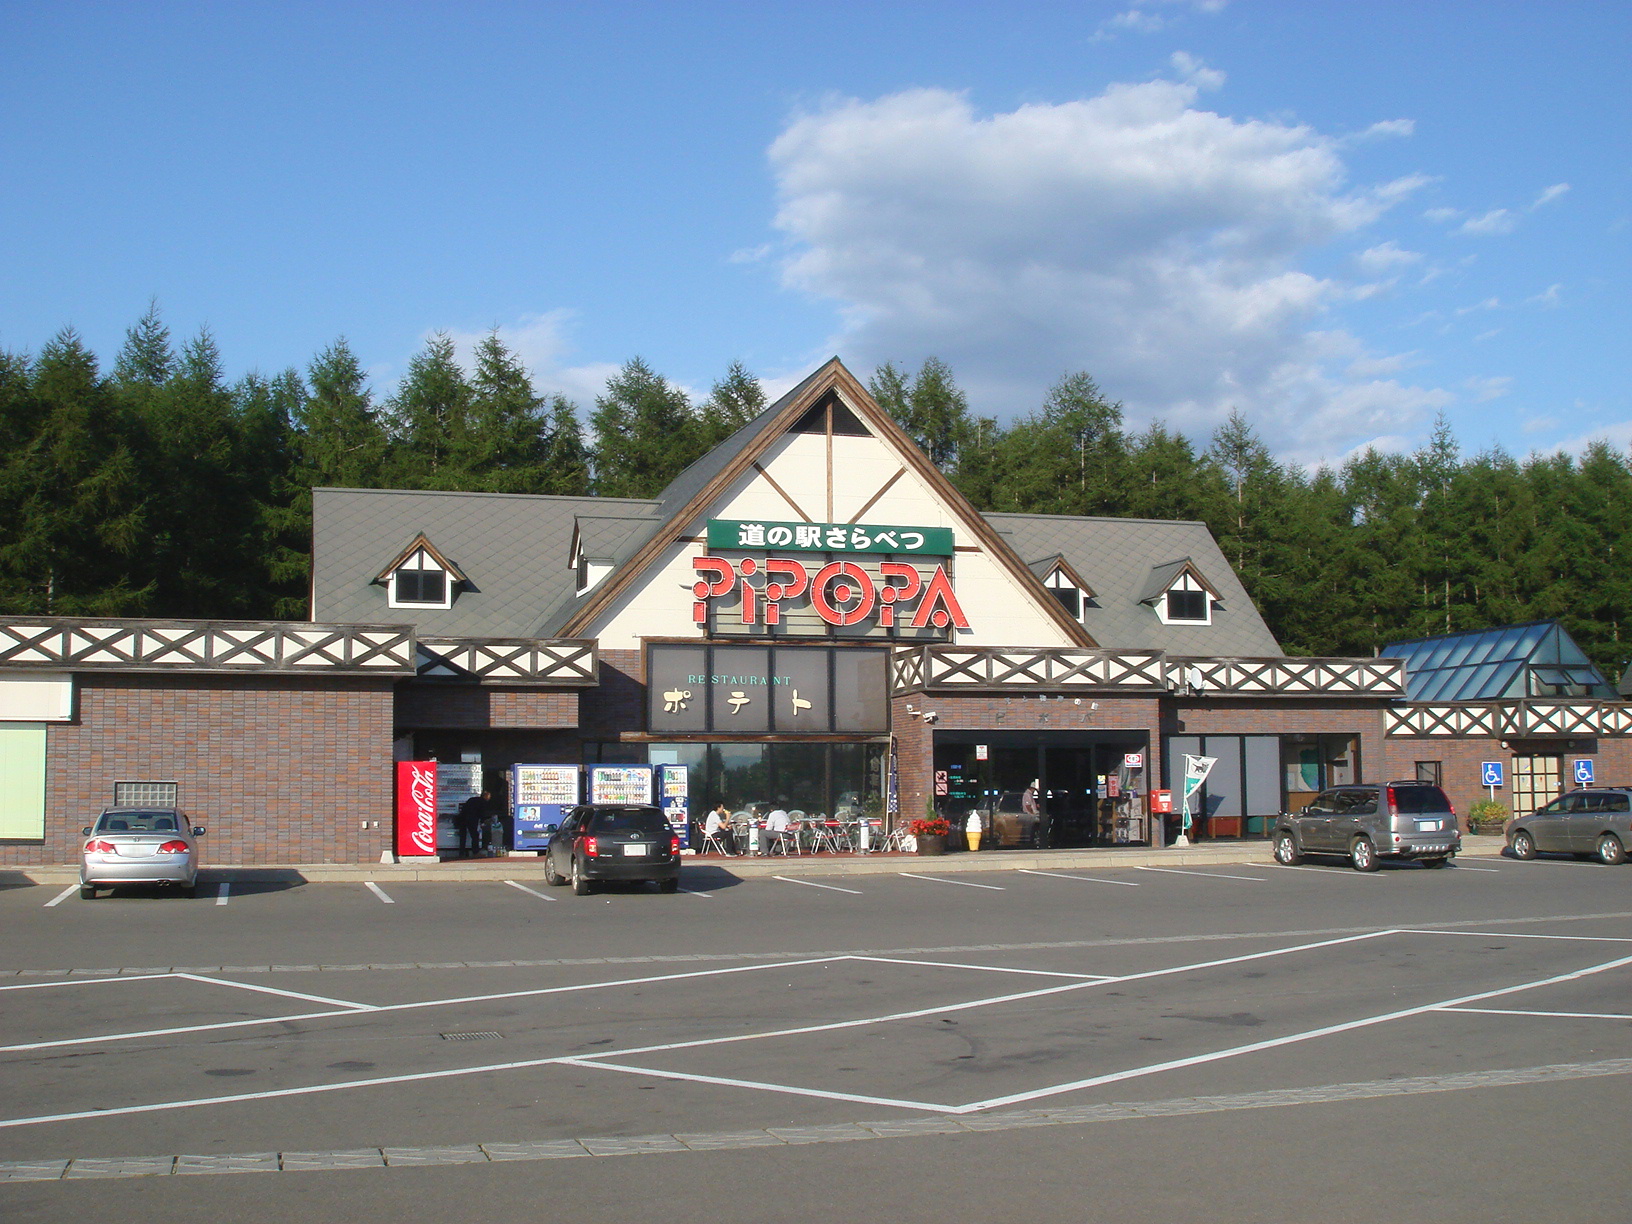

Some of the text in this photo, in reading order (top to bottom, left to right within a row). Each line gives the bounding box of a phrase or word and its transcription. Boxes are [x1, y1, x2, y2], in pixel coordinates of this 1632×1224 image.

[738, 523, 925, 550] 道の駅さらべつ
[688, 674, 791, 686] RESTAURANT
[663, 687, 812, 717] ポテト
[411, 764, 434, 853] Coca-Cola
